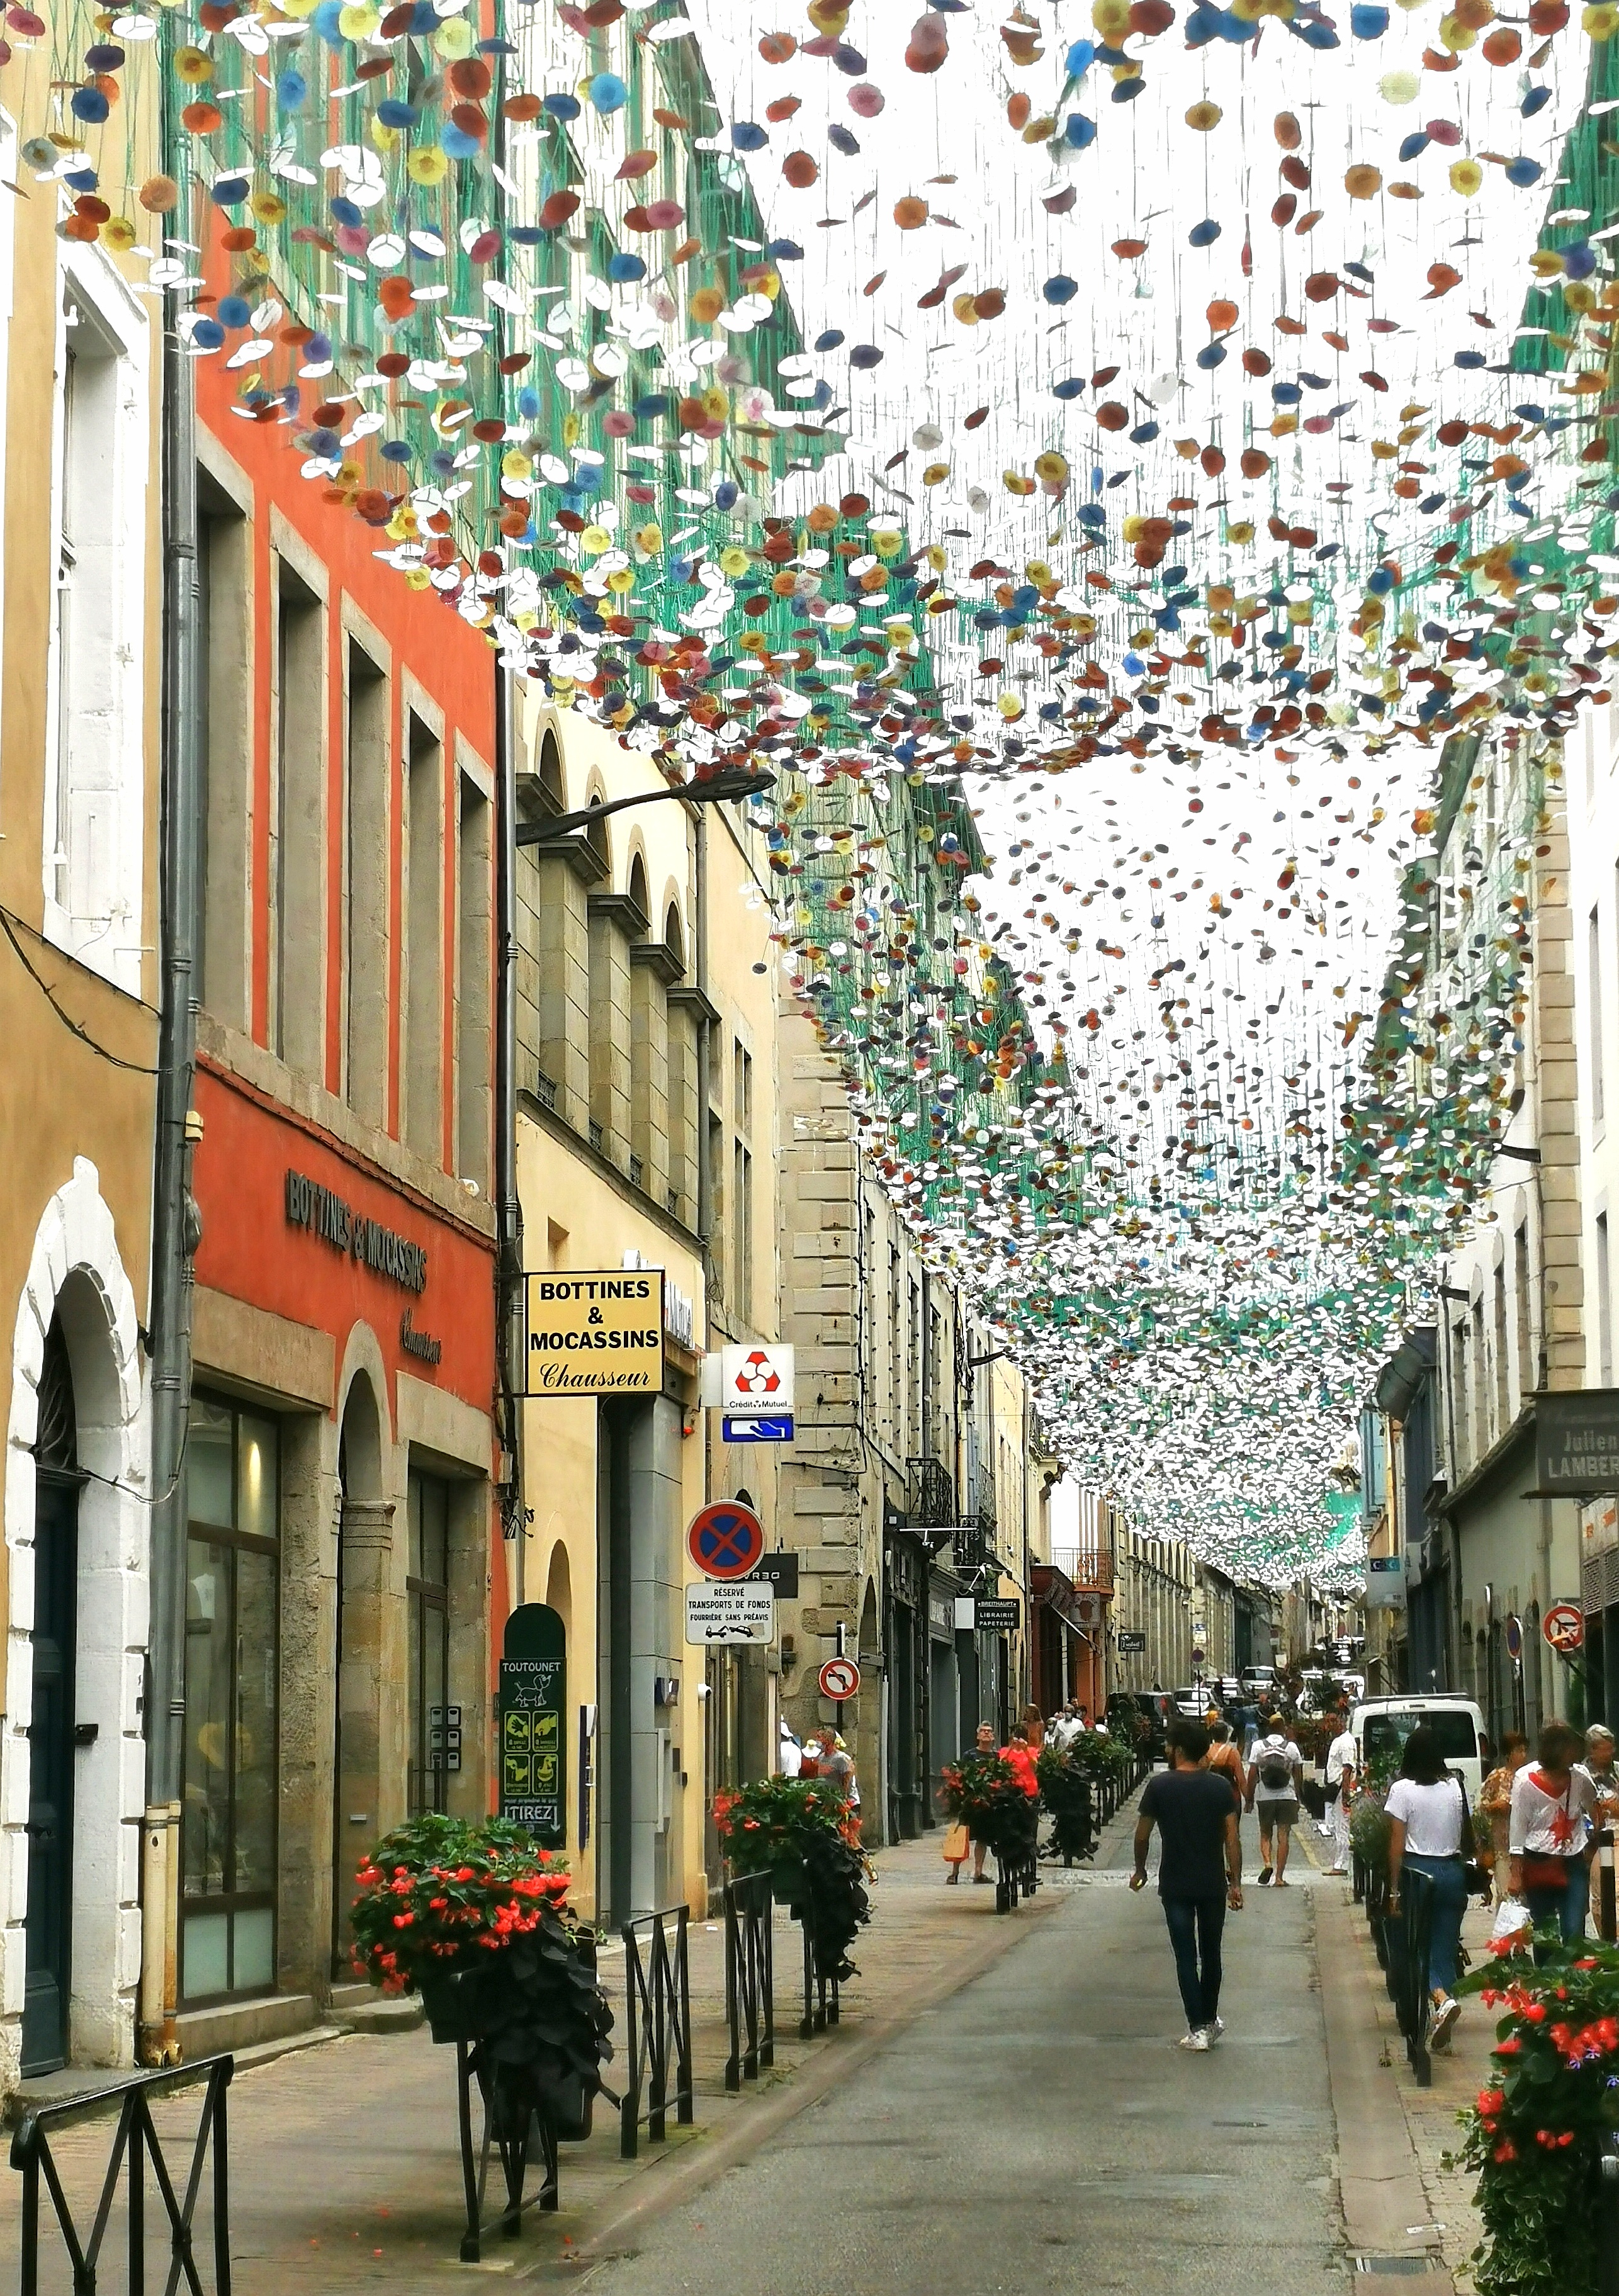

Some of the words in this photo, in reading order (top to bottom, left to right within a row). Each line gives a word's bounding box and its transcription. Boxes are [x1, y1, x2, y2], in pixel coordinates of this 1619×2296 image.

[288, 1169, 351, 1251] BOTTINES
[355, 1212, 364, 1259] &
[366, 1218, 427, 1293] MOCASSINS
[540, 1280, 650, 1300] BOTTINES
[588, 1306, 604, 1324] &
[531, 1329, 659, 1351] MOCASSINS
[540, 1362, 651, 1388] Chausseur
[730, 1400, 753, 1409] Crédit
[762, 1400, 787, 1408] Mutuel
[1564, 1429, 1618, 1452] Julien
[714, 1587, 745, 1597] RÉSERVÉ
[689, 1601, 732, 1609] TRANSPORTS
[735, 1601, 744, 1609] DE
[748, 1601, 770, 1609] FONDS
[690, 1613, 722, 1621] FOURRIÈRE
[743, 1612, 769, 1621] PRÉAVIS
[502, 1662, 561, 1672] TOUTOUNET
[509, 1805, 553, 1820] TIREZ
